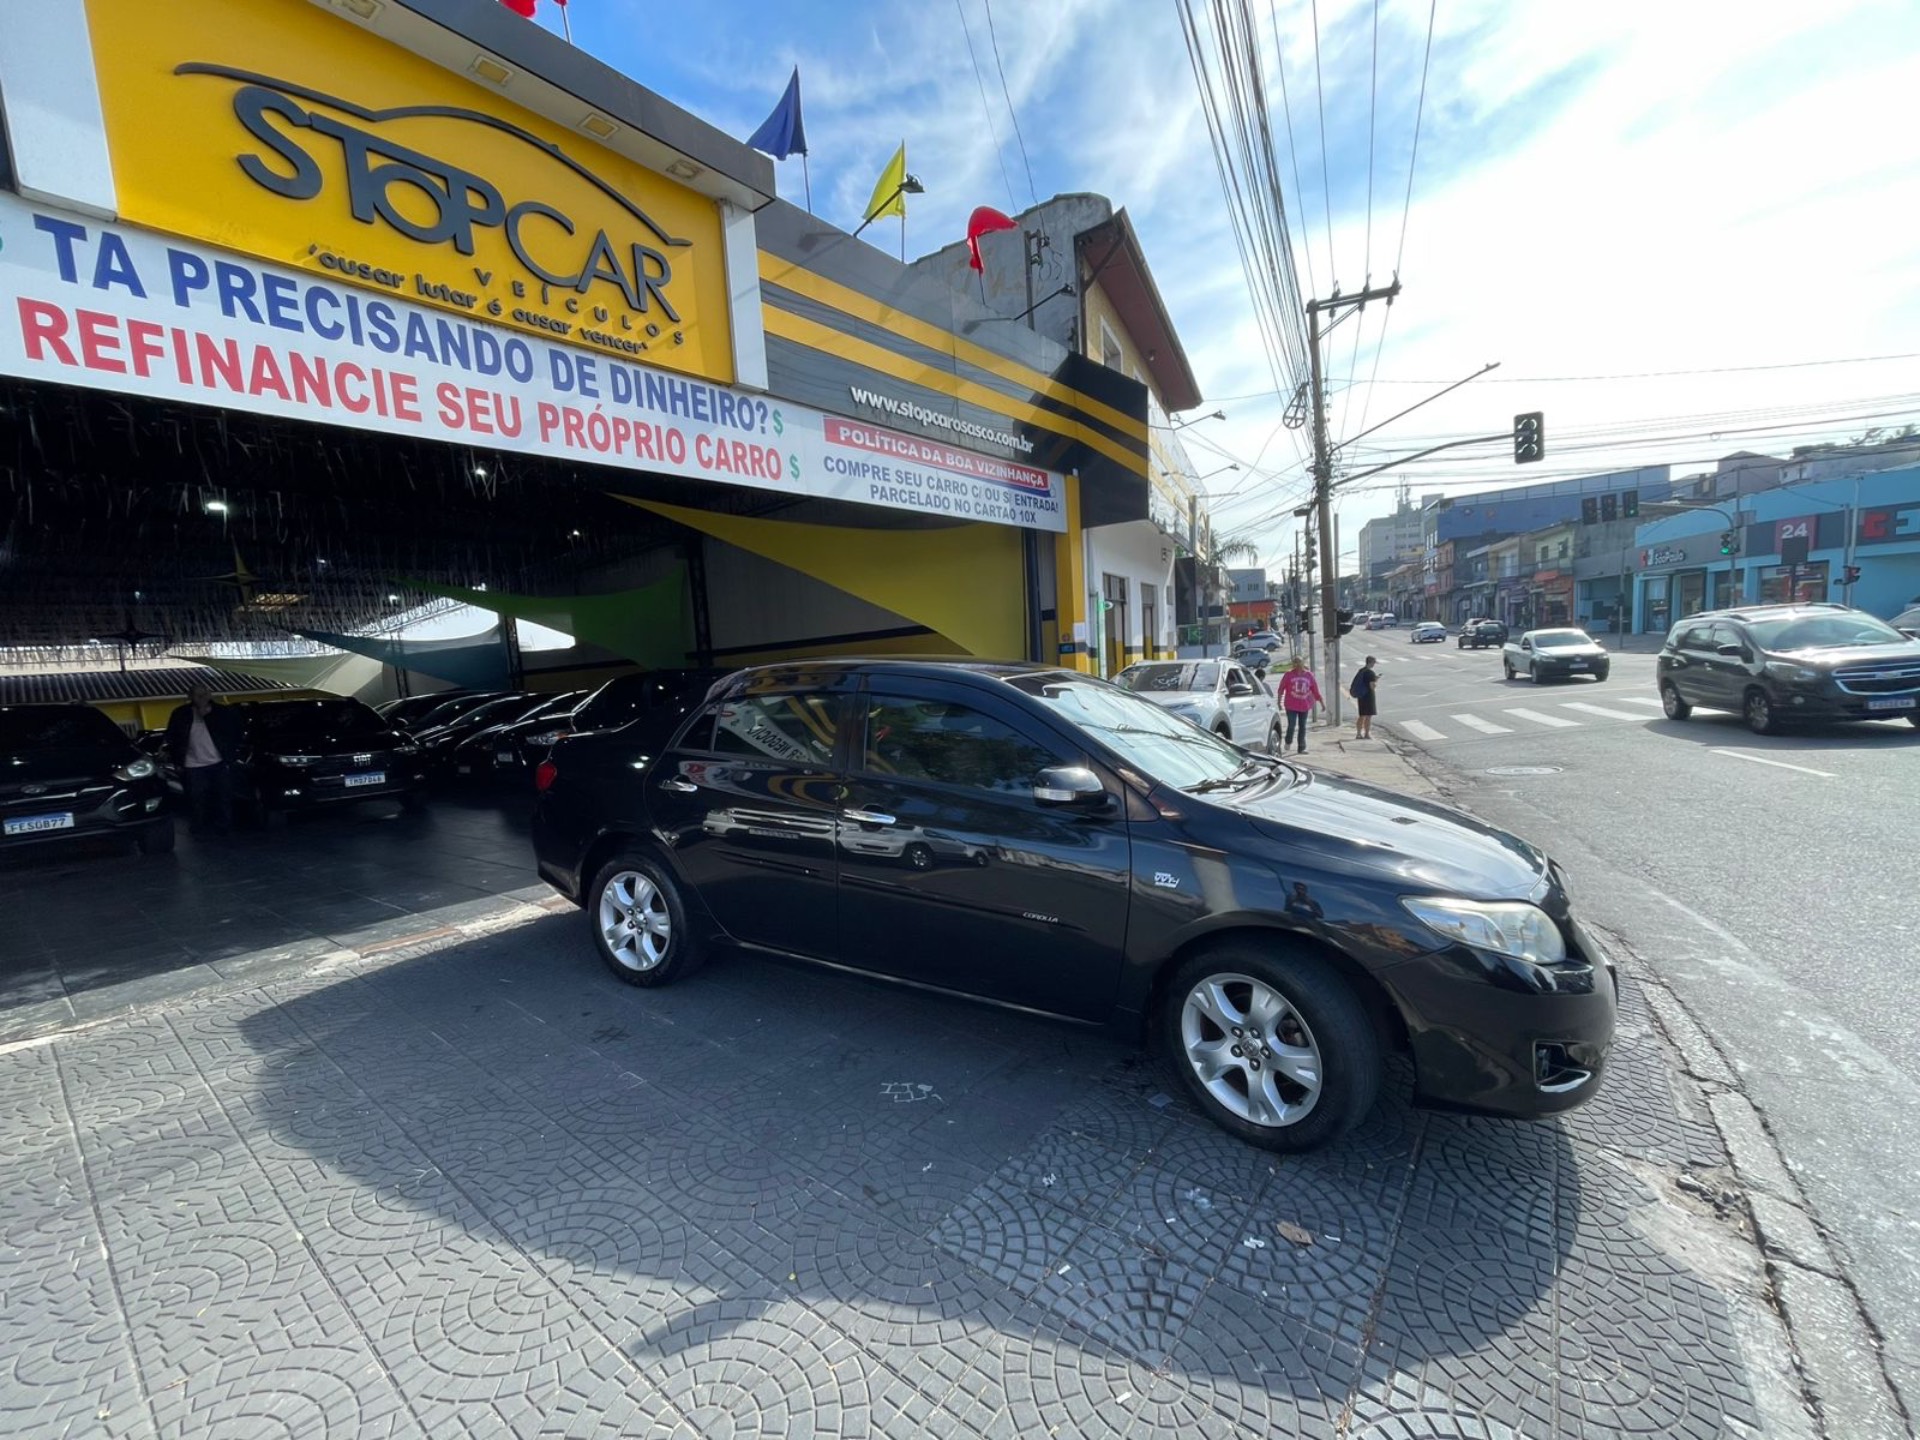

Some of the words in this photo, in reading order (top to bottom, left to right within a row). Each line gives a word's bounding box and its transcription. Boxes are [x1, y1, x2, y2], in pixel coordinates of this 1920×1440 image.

[33, 213, 148, 299] TA
[167, 247, 534, 384] PRECISANDO
[548, 347, 600, 399] DE
[609, 363, 768, 434] DINHEIRO?
[416, 273, 477, 309] lutar
[487, 297, 502, 316] é
[512, 308, 572, 335] ousar
[16, 296, 423, 421] REFINANCIE
[439, 381, 522, 438] SEU
[537, 401, 686, 465] PRÓPRIO
[695, 433, 782, 481] CARRO
[851, 386, 1034, 453] www.stopcarosasco.com.br
[823, 455, 891, 483] COMPRE
[895, 469, 922, 488] SEU
[926, 475, 968, 497] CARRO
[984, 487, 1000, 502] OU
[1014, 493, 1059, 513] ENTRADA!
[839, 426, 919, 458] POLÍTICA
[922, 446, 943, 464] DA
[946, 452, 973, 471] BOA
[976, 460, 1045, 487] VIZINHANÇA
[870, 484, 951, 511] PARCELADO
[954, 498, 971, 514] NO
[1020, 509, 1037, 524] 10X
[1781, 522, 1808, 539] 24
